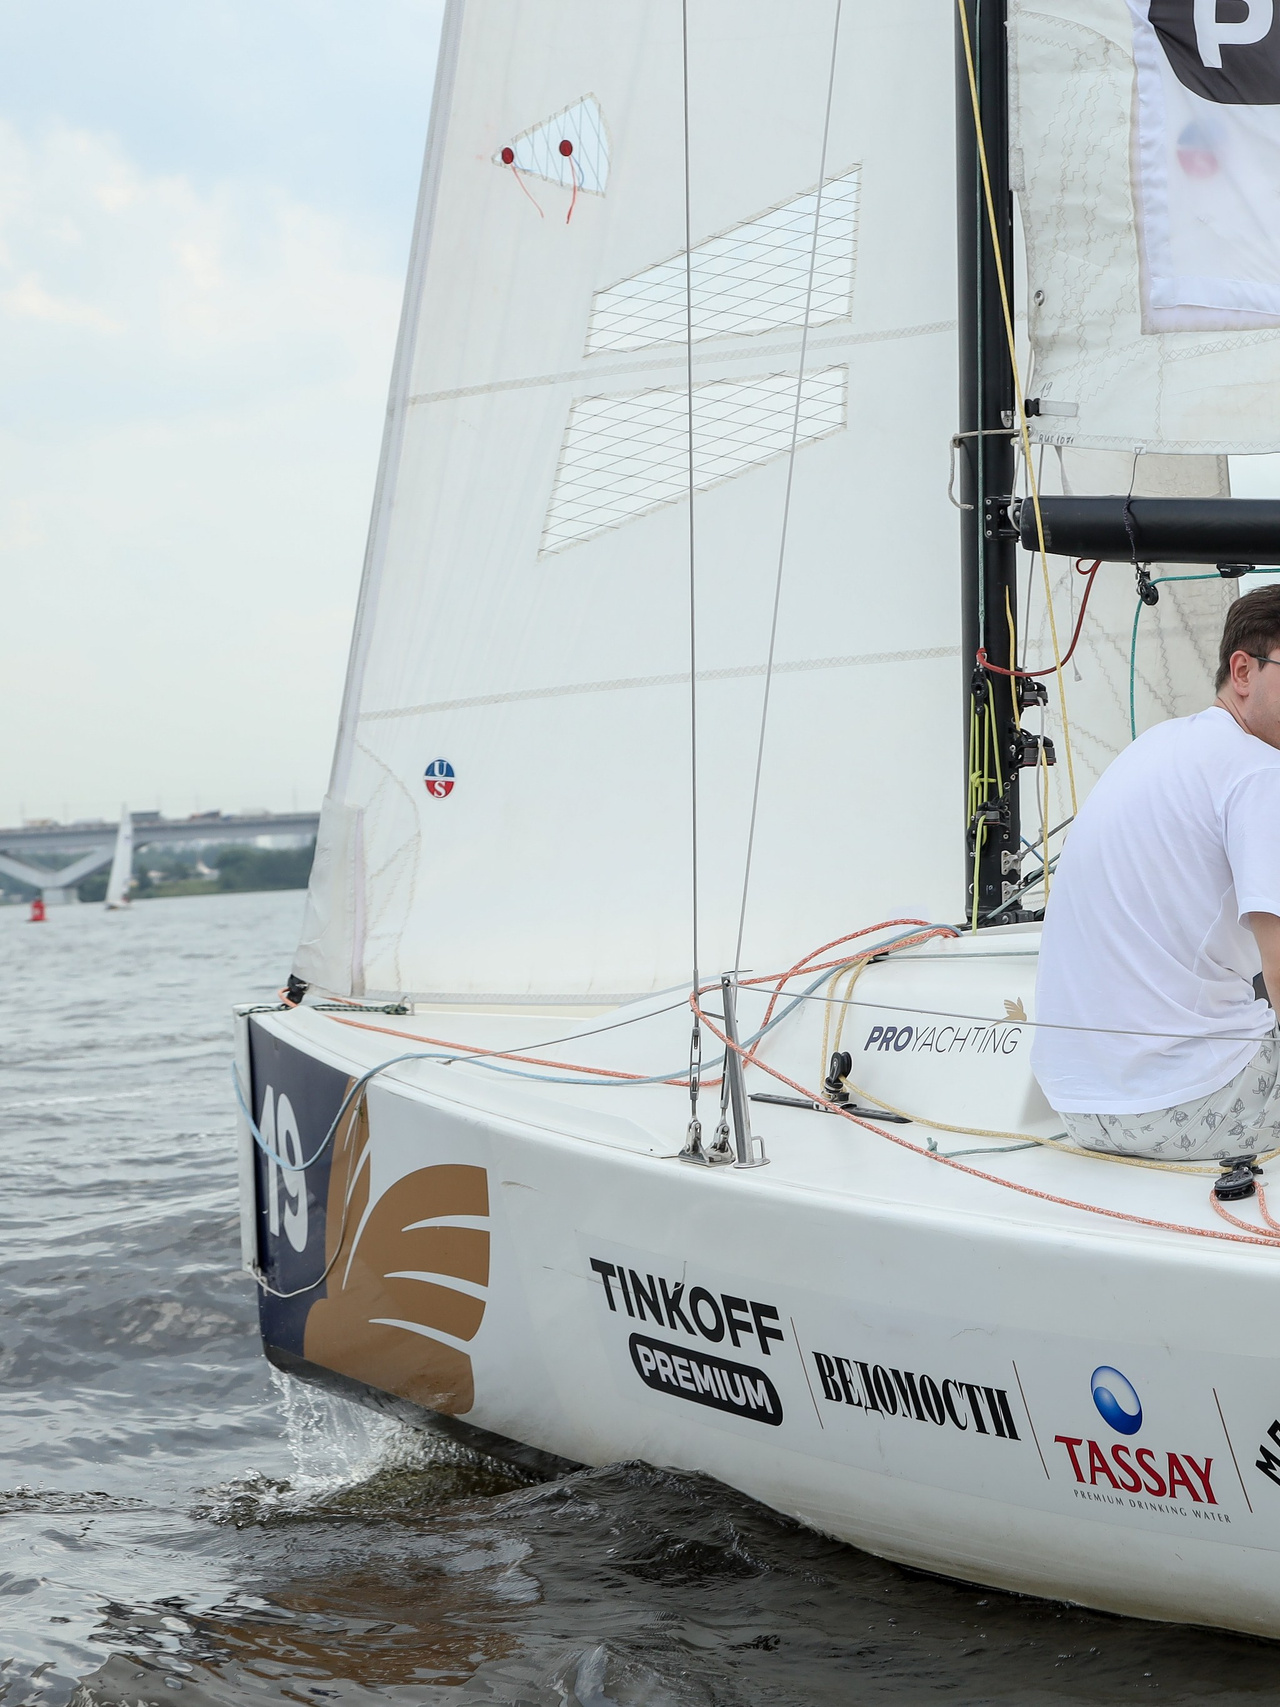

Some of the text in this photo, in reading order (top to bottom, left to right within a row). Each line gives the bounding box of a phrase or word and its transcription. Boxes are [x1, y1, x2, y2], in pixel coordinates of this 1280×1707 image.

[1040, 382, 1053, 398] 19
[863, 1025, 1022, 1055] PROYACHTING
[259, 1084, 309, 1253] 19
[589, 1257, 784, 1356] TINKOFF
[635, 1345, 774, 1415] PREMIUM
[811, 1351, 1022, 1441] ВЕДОМОСТИ
[1054, 1435, 1219, 1506] TASSAY
[1073, 1489, 1232, 1524] PREMIUM DRINKING WATER
